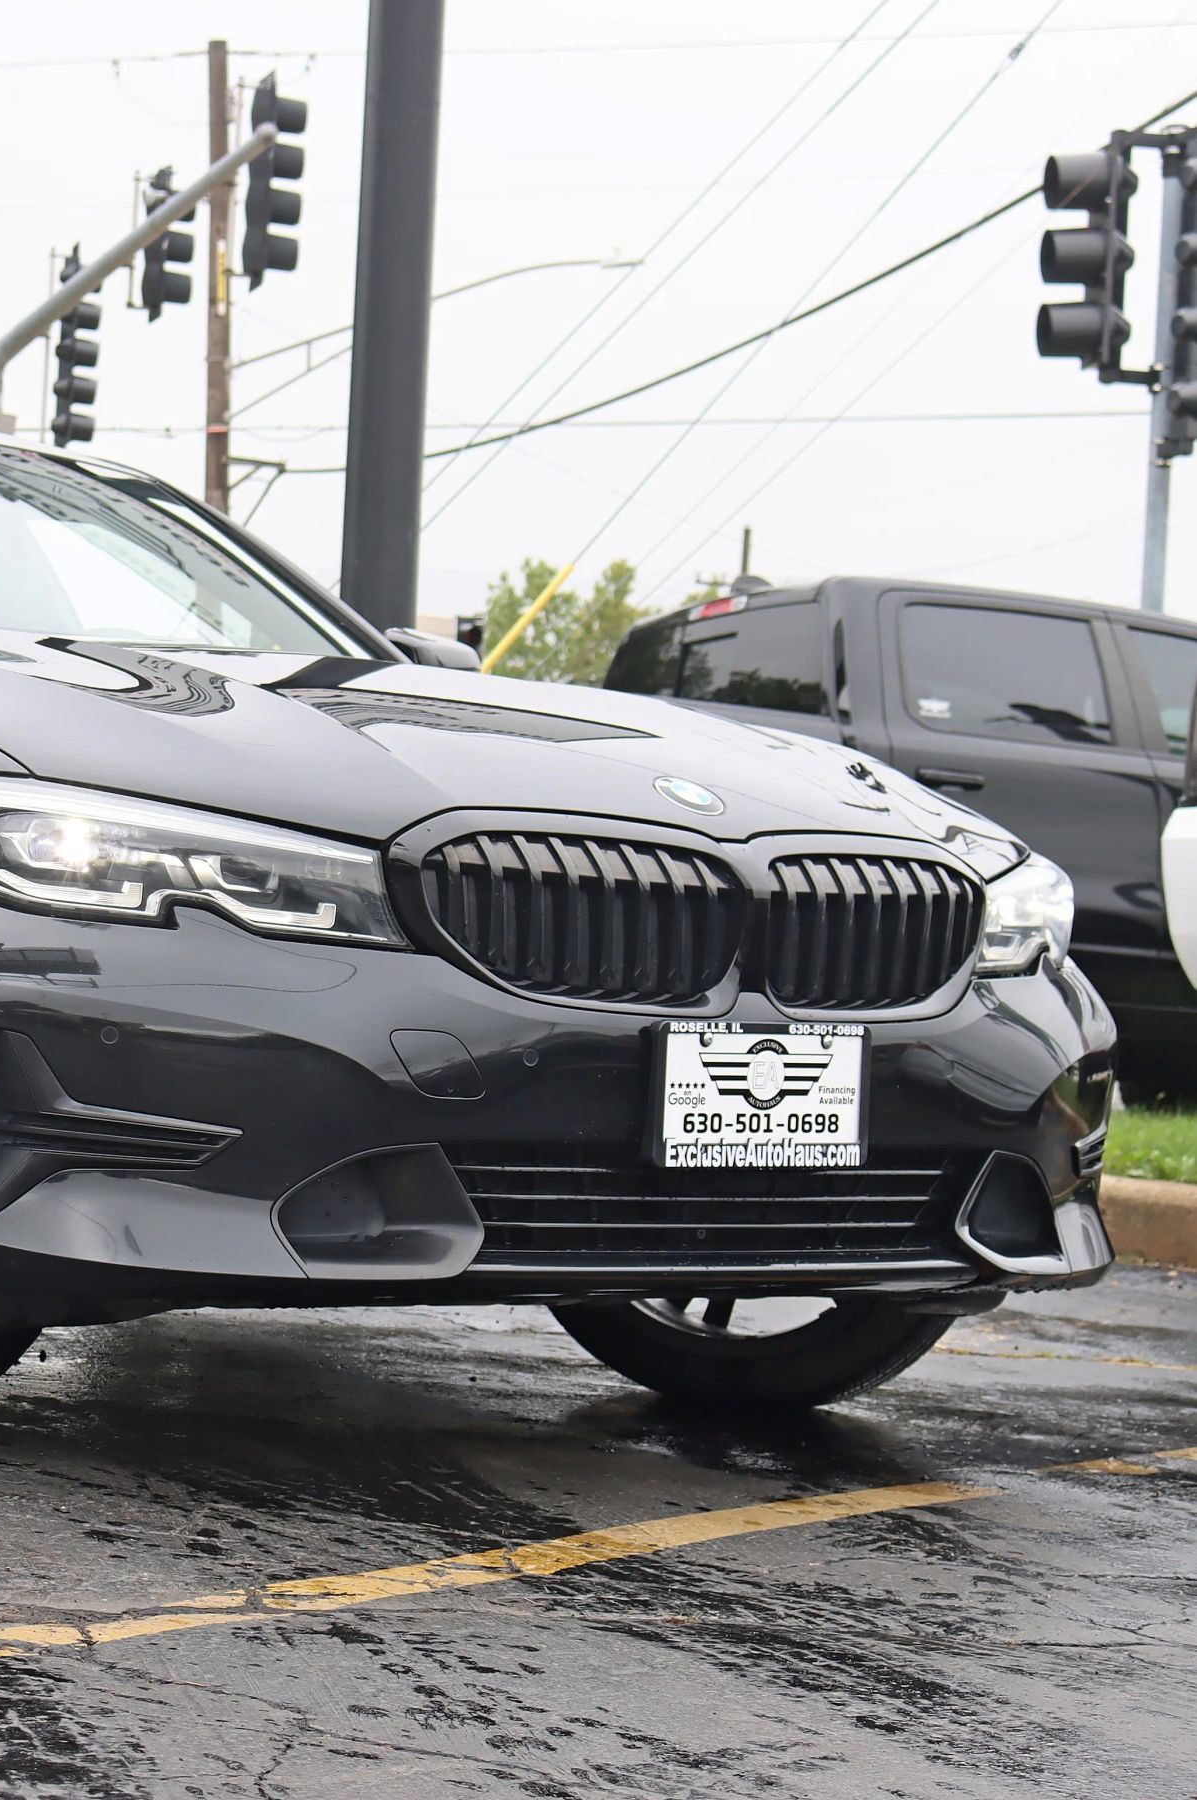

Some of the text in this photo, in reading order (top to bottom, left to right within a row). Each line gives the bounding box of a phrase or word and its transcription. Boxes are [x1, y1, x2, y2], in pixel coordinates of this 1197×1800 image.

[670, 1022, 744, 1034] ROSELLE, IL
[788, 1024, 864, 1036] 630-501-0698
[752, 1041, 784, 1054] EXCLUSIVE
[818, 1085, 856, 1097] Financing
[668, 1093, 706, 1109] Google
[747, 1095, 781, 1108] AUTOHAUS
[819, 1096, 855, 1105] Available
[683, 1113, 840, 1134] 630-501-0698
[665, 1138, 861, 1168] ExclusiveAutoHaus.com
